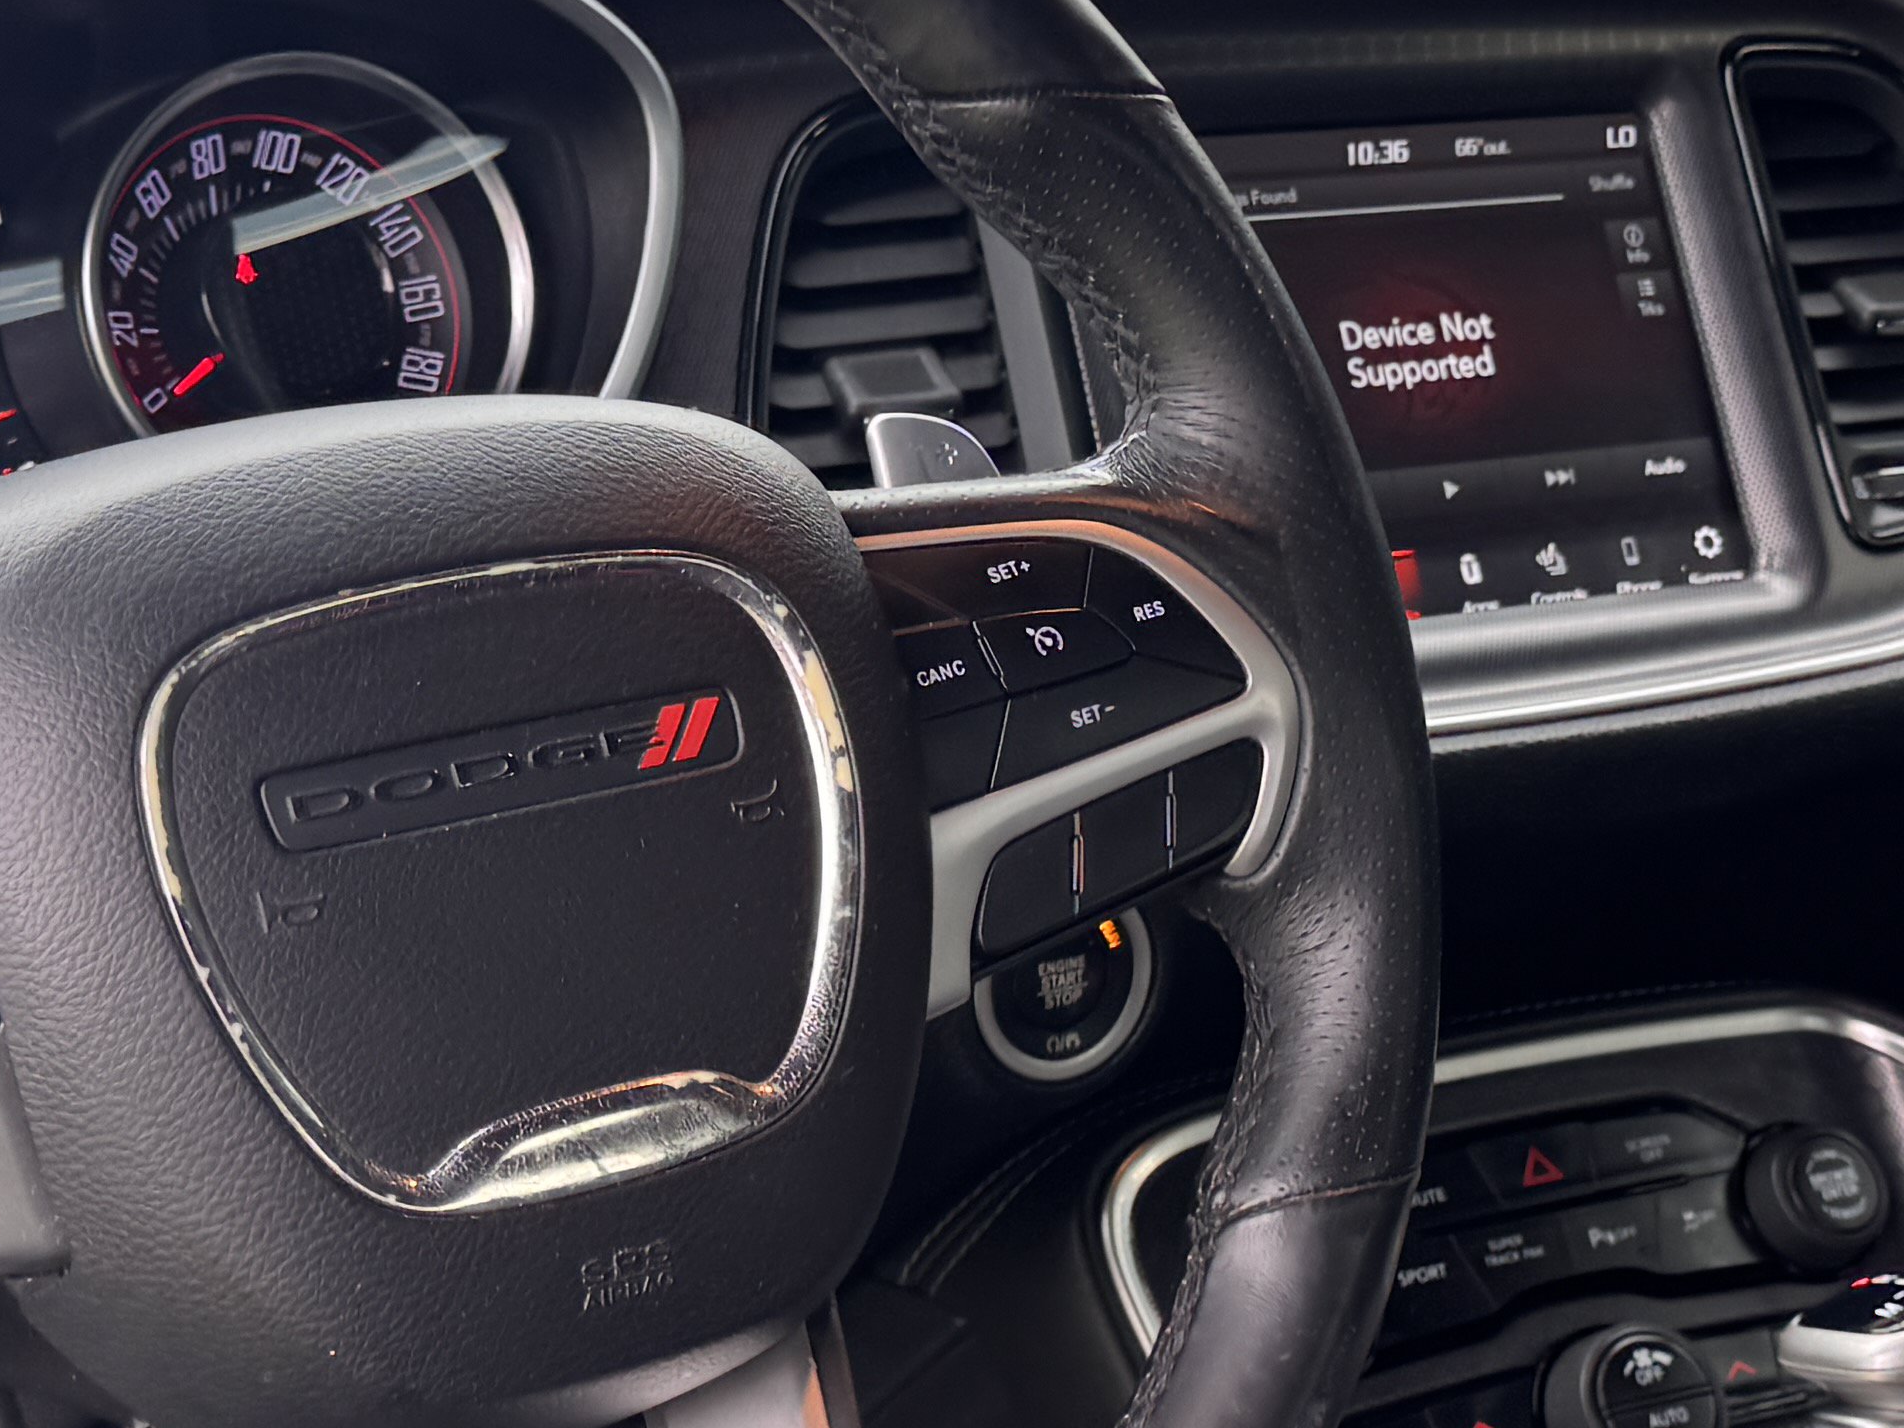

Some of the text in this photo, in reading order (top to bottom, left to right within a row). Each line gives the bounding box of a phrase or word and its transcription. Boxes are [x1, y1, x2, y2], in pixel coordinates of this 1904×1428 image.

[190, 133, 227, 180] 80
[252, 128, 302, 174] 100
[1347, 139, 1411, 167] 10:36
[1606, 125, 1638, 149] LO
[135, 169, 173, 220] 60
[315, 152, 370, 206] 120
[1250, 187, 1298, 206] Found
[108, 232, 138, 278] 40
[369, 212, 424, 259] 140
[398, 275, 445, 323] 160
[107, 311, 139, 348] 20
[1338, 311, 1496, 352] Device Not
[398, 346, 445, 393] 180
[1346, 345, 1497, 392] Supported
[143, 387, 168, 414] 0
[1133, 600, 1166, 622] RES
[916, 659, 966, 689] CANC
[286, 719, 662, 824] DODGE
[1038, 955, 1085, 977] ENGINE
[1041, 969, 1083, 988] START
[1044, 987, 1083, 1010] STOP
[1397, 1262, 1446, 1288] SPORT
